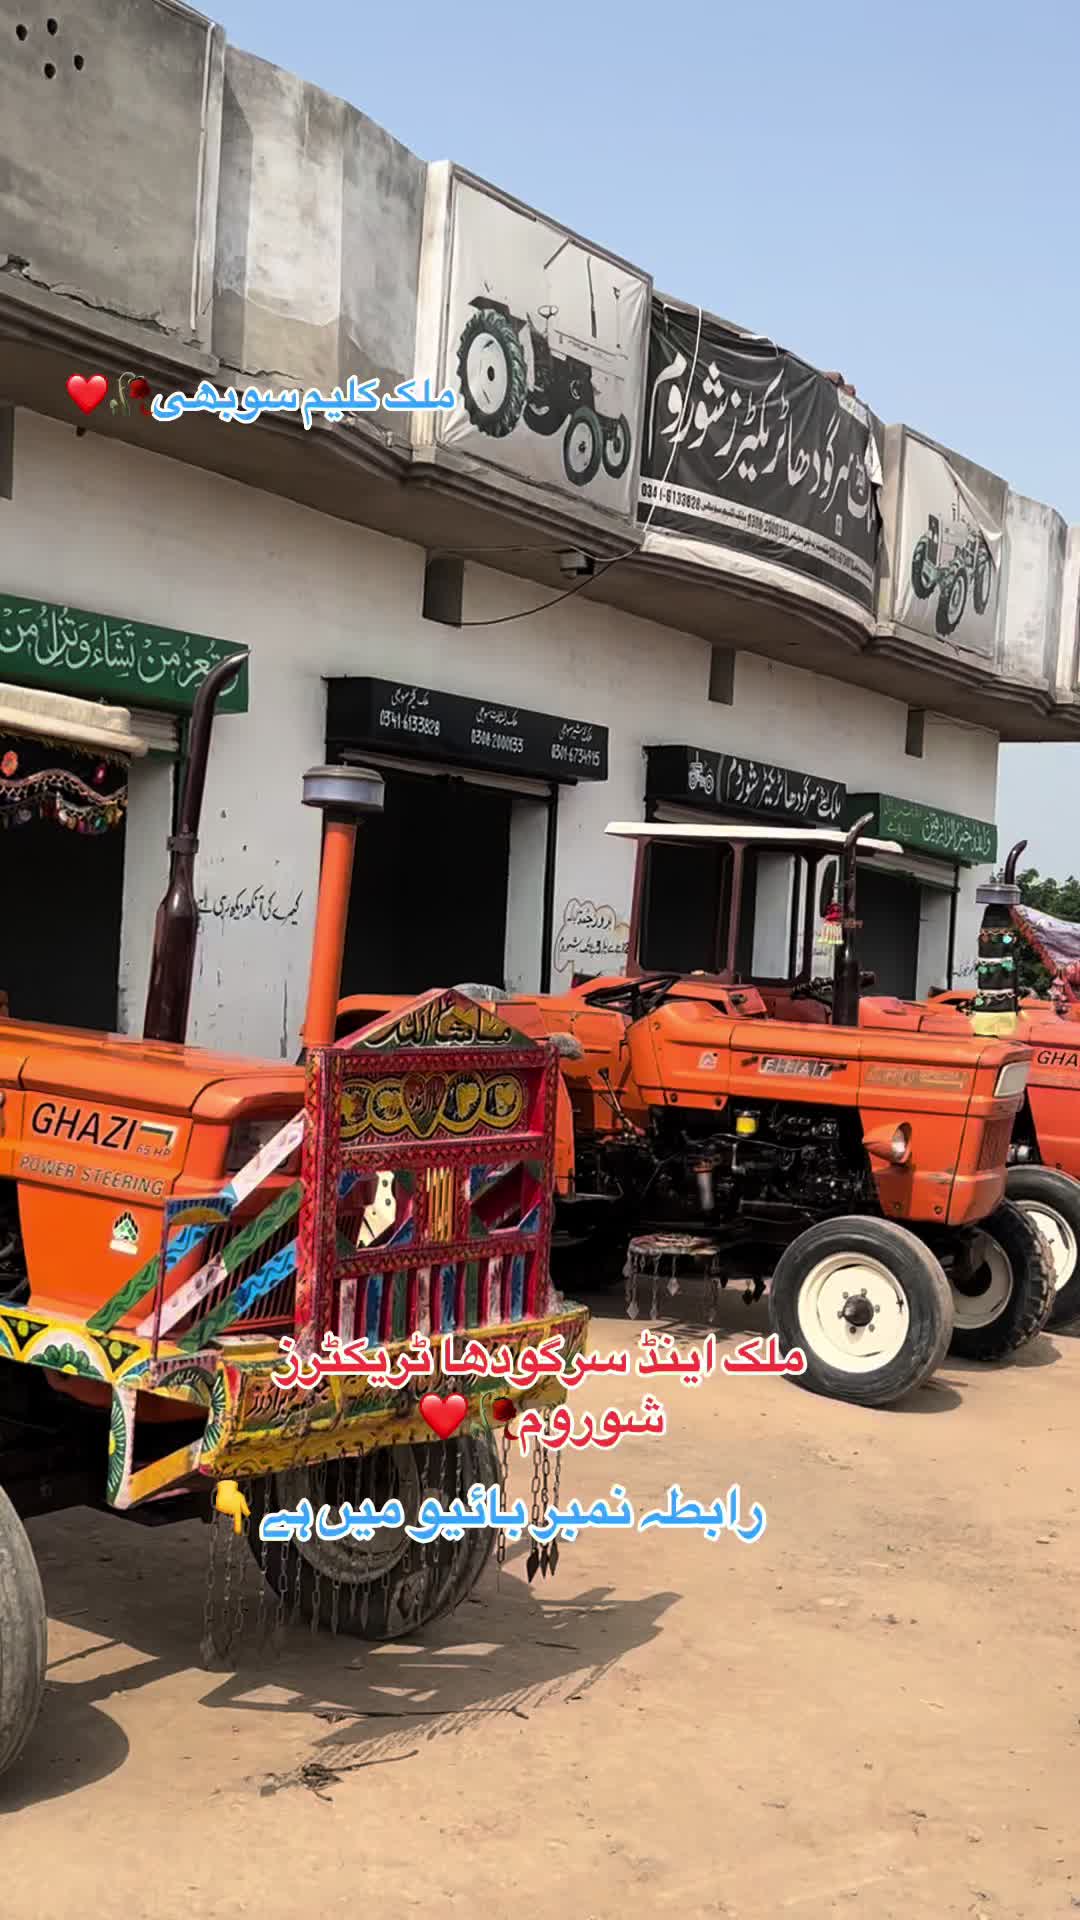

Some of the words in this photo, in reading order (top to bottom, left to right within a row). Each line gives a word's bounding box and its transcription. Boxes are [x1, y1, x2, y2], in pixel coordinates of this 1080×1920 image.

[32, 1102, 138, 1150] GHAZI
[20, 1156, 76, 1178] POWER
[81, 1167, 164, 1196] STEERING
